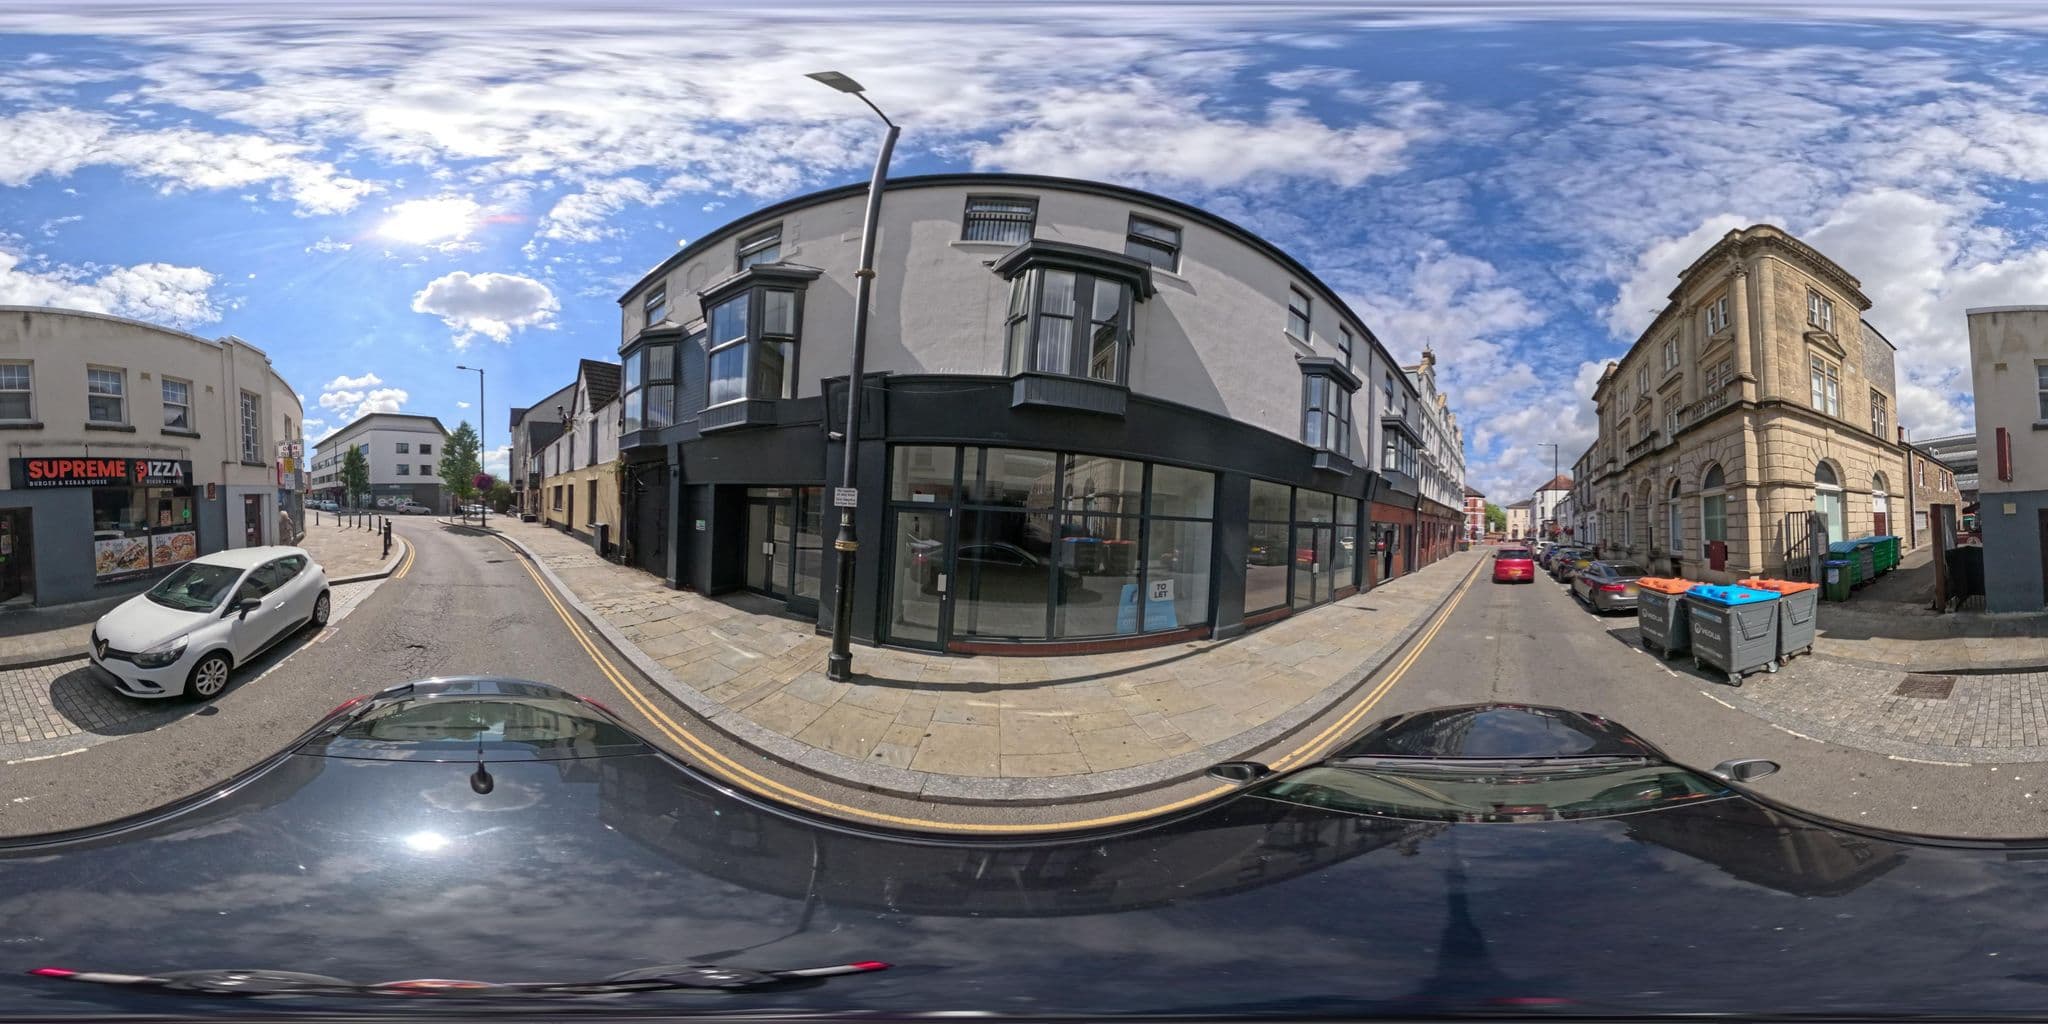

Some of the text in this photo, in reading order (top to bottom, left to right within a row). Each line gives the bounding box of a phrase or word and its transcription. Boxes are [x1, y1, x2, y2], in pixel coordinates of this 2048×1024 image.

[28, 460, 183, 482] SUPREME PIZZA
[1701, 628, 1721, 641] VEOLIA
